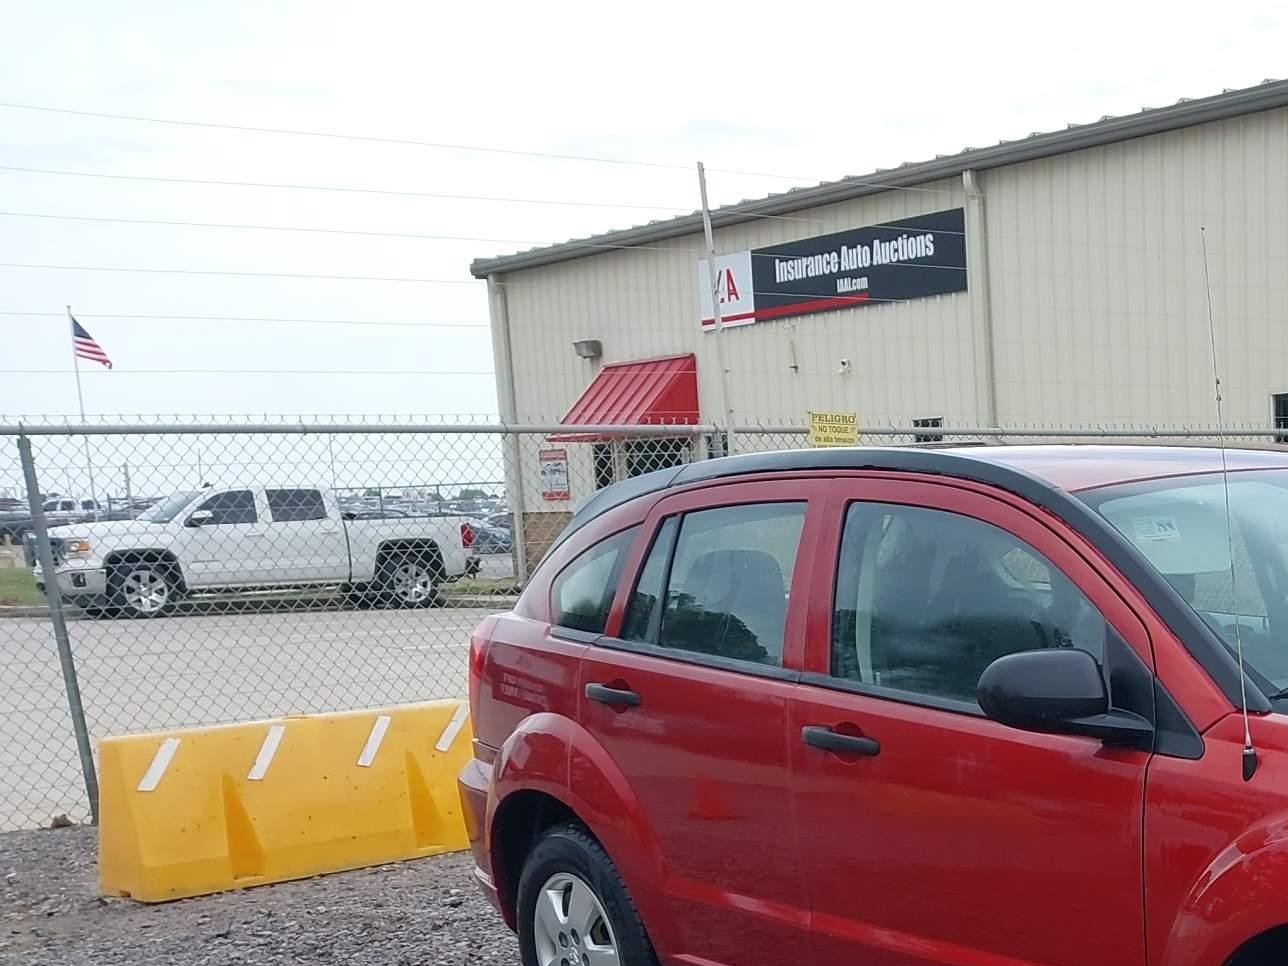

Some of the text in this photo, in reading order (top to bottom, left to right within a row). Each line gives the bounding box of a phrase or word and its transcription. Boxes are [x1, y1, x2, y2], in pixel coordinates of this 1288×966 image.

[775, 233, 935, 283] Insurance Auto Auctions
[811, 413, 855, 424] PELIGRO
[818, 425, 828, 433] NO
